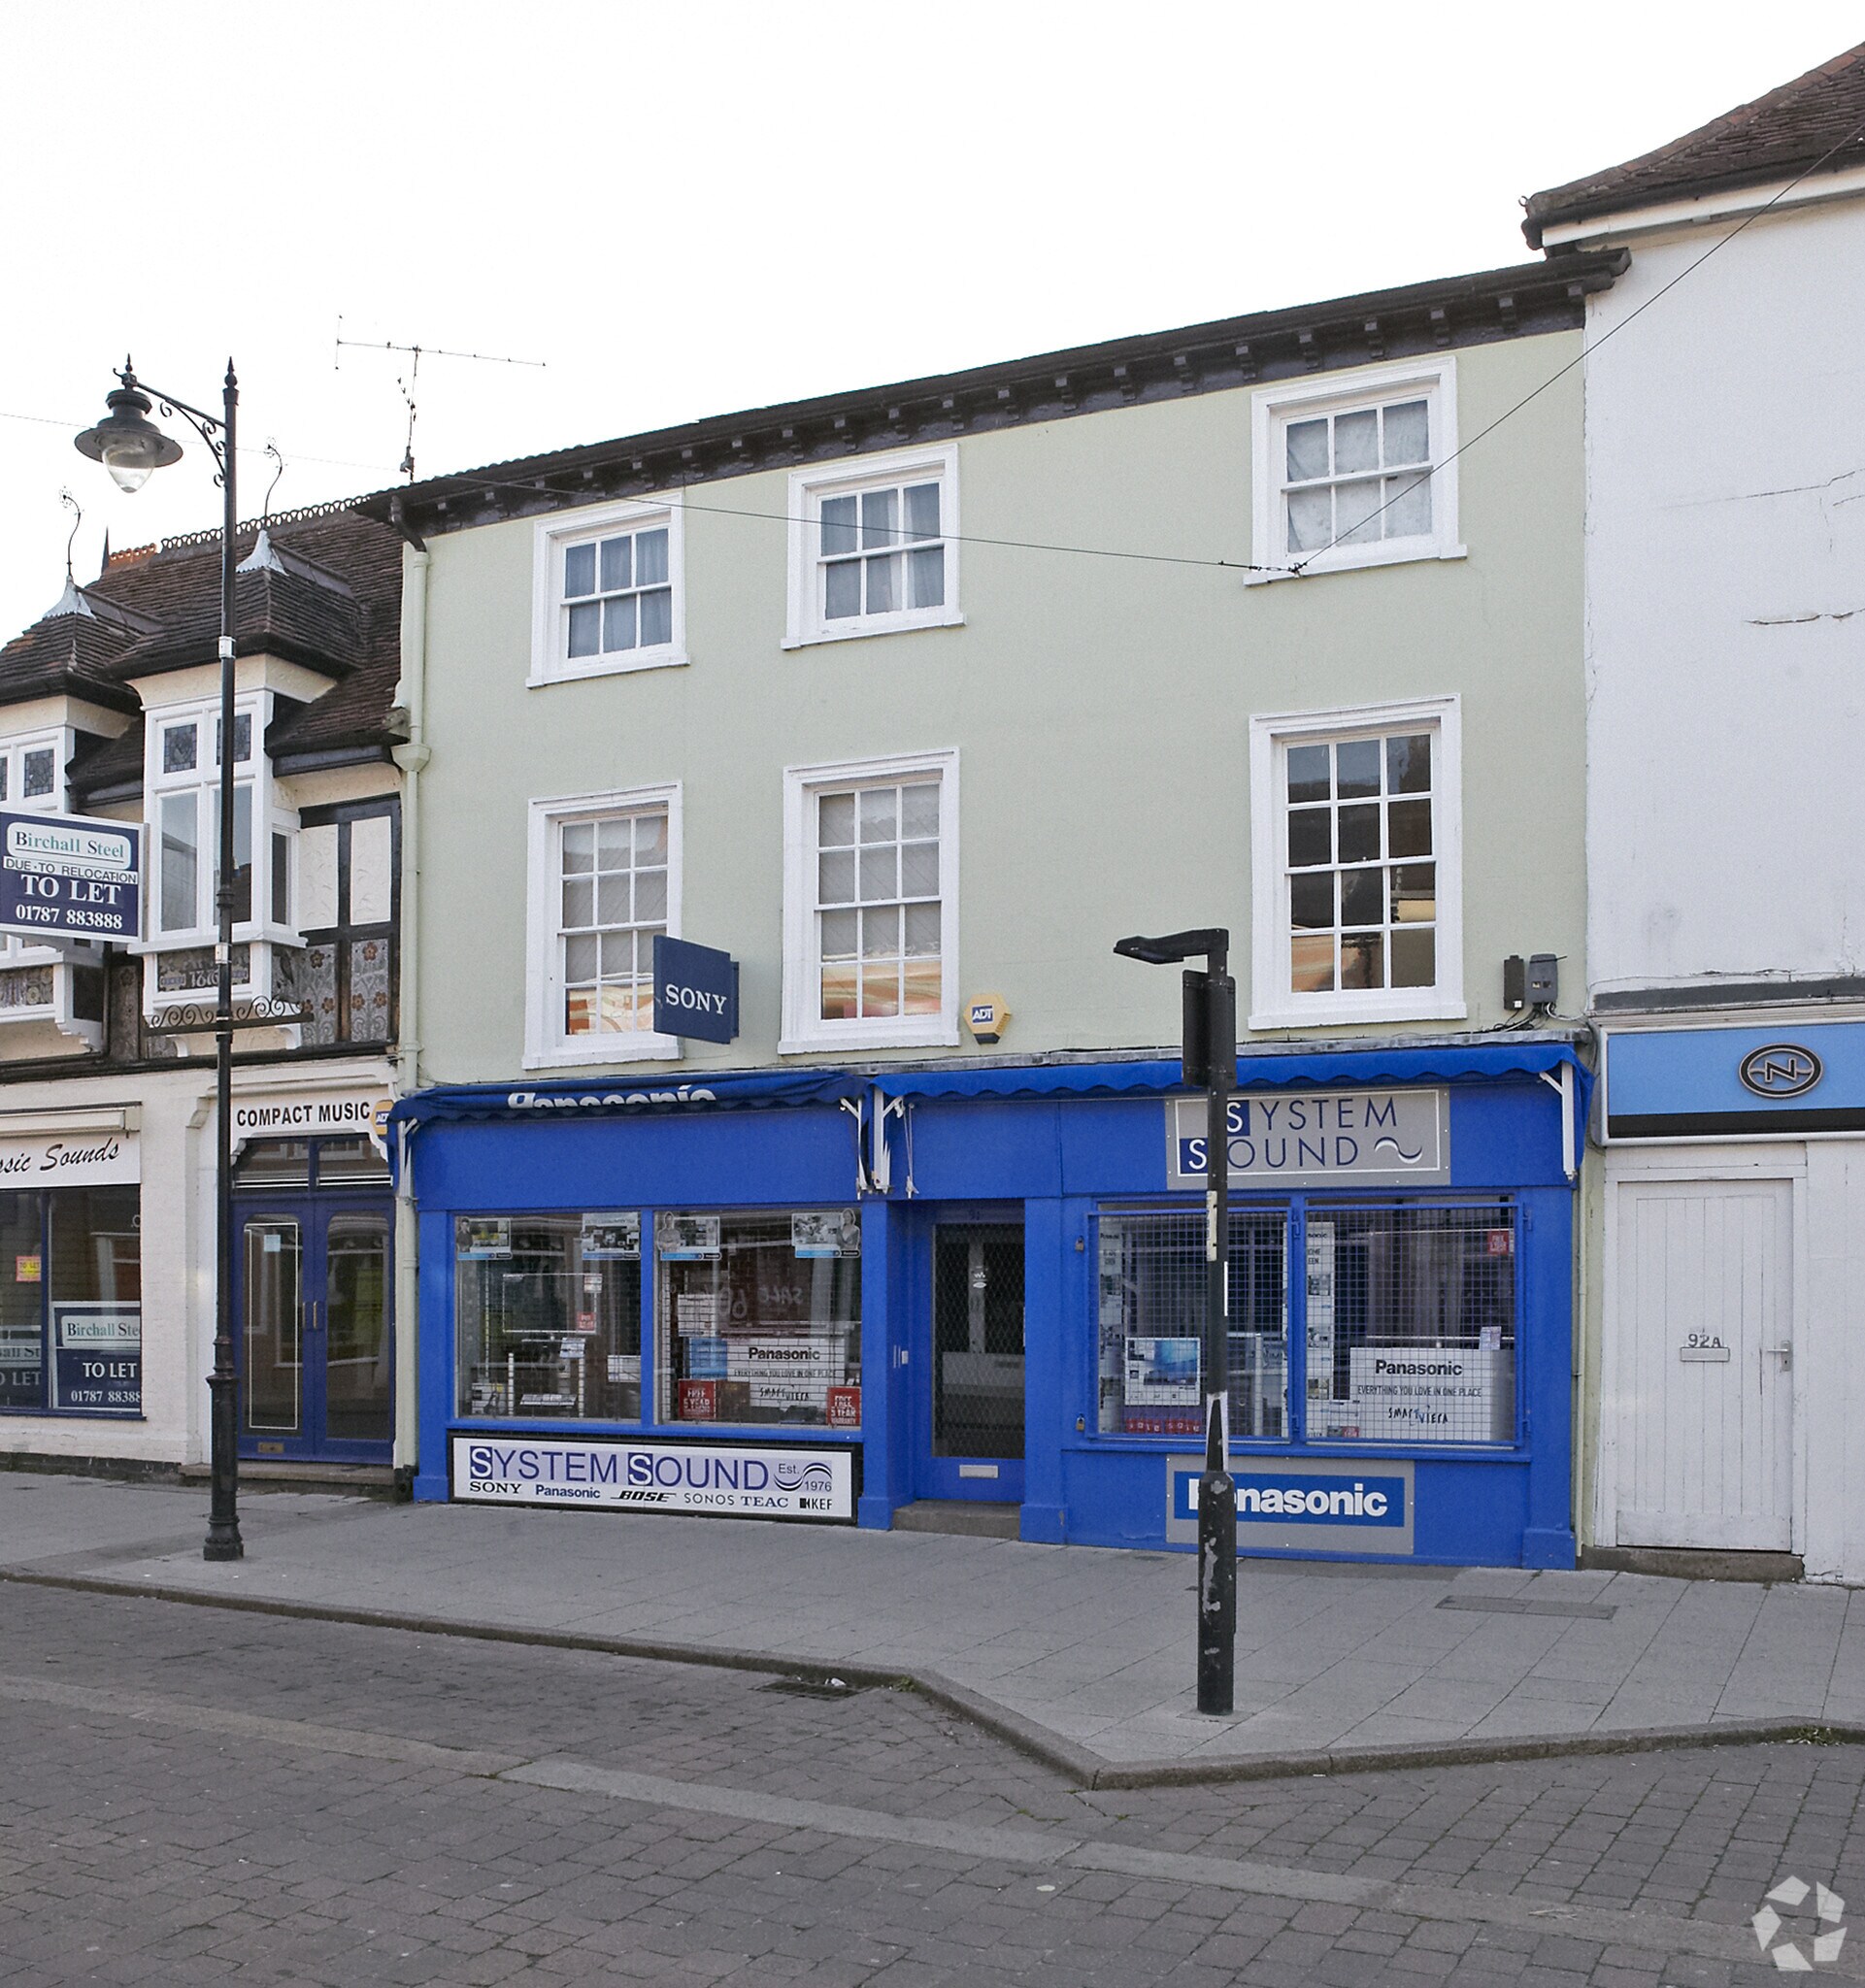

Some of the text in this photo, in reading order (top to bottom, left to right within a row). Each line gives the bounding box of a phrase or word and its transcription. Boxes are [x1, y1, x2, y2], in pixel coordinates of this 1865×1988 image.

[16, 831, 124, 858] Birchall Steel
[62, 866, 136, 883] RELOCATION
[20, 874, 121, 905] TO LET
[16, 904, 122, 929] 01787 883888
[665, 983, 727, 1015] SONY
[972, 1009, 993, 1020] ADT
[237, 1102, 371, 1127] COMPACT MUSIC
[1227, 1097, 1397, 1132] SYSTEM
[40, 1137, 118, 1171] Sounds
[1188, 1137, 1358, 1169] SOUND
[68, 1323, 115, 1337] Birchall
[1688, 1333, 1722, 1348] 92A
[749, 1347, 820, 1360] Panasonic
[83, 1362, 137, 1377] TO LET
[1376, 1359, 1463, 1375] Panasonic
[12, 1371, 41, 1386] LET
[71, 1390, 103, 1402] 01787
[1359, 1385, 1482, 1397] EVERYTHING YOU LOVE IN ONE PLACE
[834, 1396, 851, 1407] FREE
[470, 1447, 769, 1491] SYSTEM SOUND
[779, 1464, 799, 1474] Est.
[805, 1481, 832, 1492] 1976
[470, 1481, 832, 1509] SONY Panasonic BOSE SONOS TEAC KEF
[1188, 1478, 1387, 1516] nasonic
